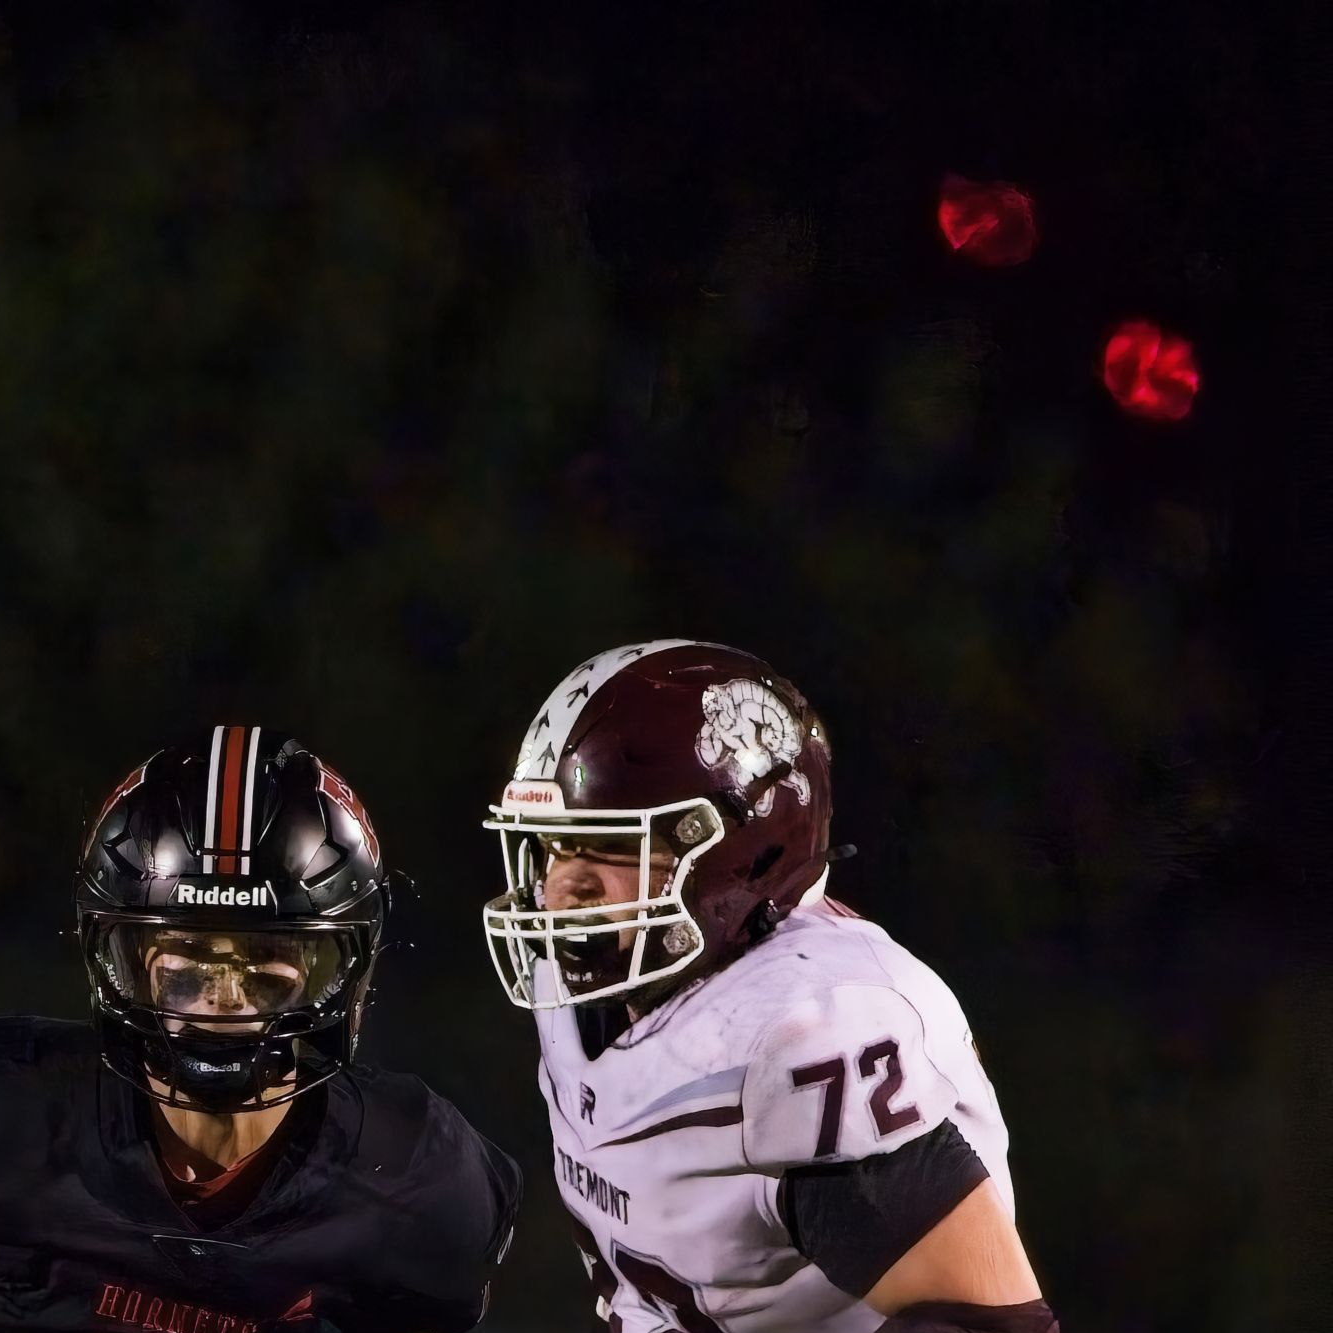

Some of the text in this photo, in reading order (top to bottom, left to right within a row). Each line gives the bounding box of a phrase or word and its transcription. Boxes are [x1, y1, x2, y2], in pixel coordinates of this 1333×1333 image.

[177, 884, 268, 906] Riddell
[786, 1036, 926, 1162] 72
[557, 1146, 631, 1226] TREMONT
